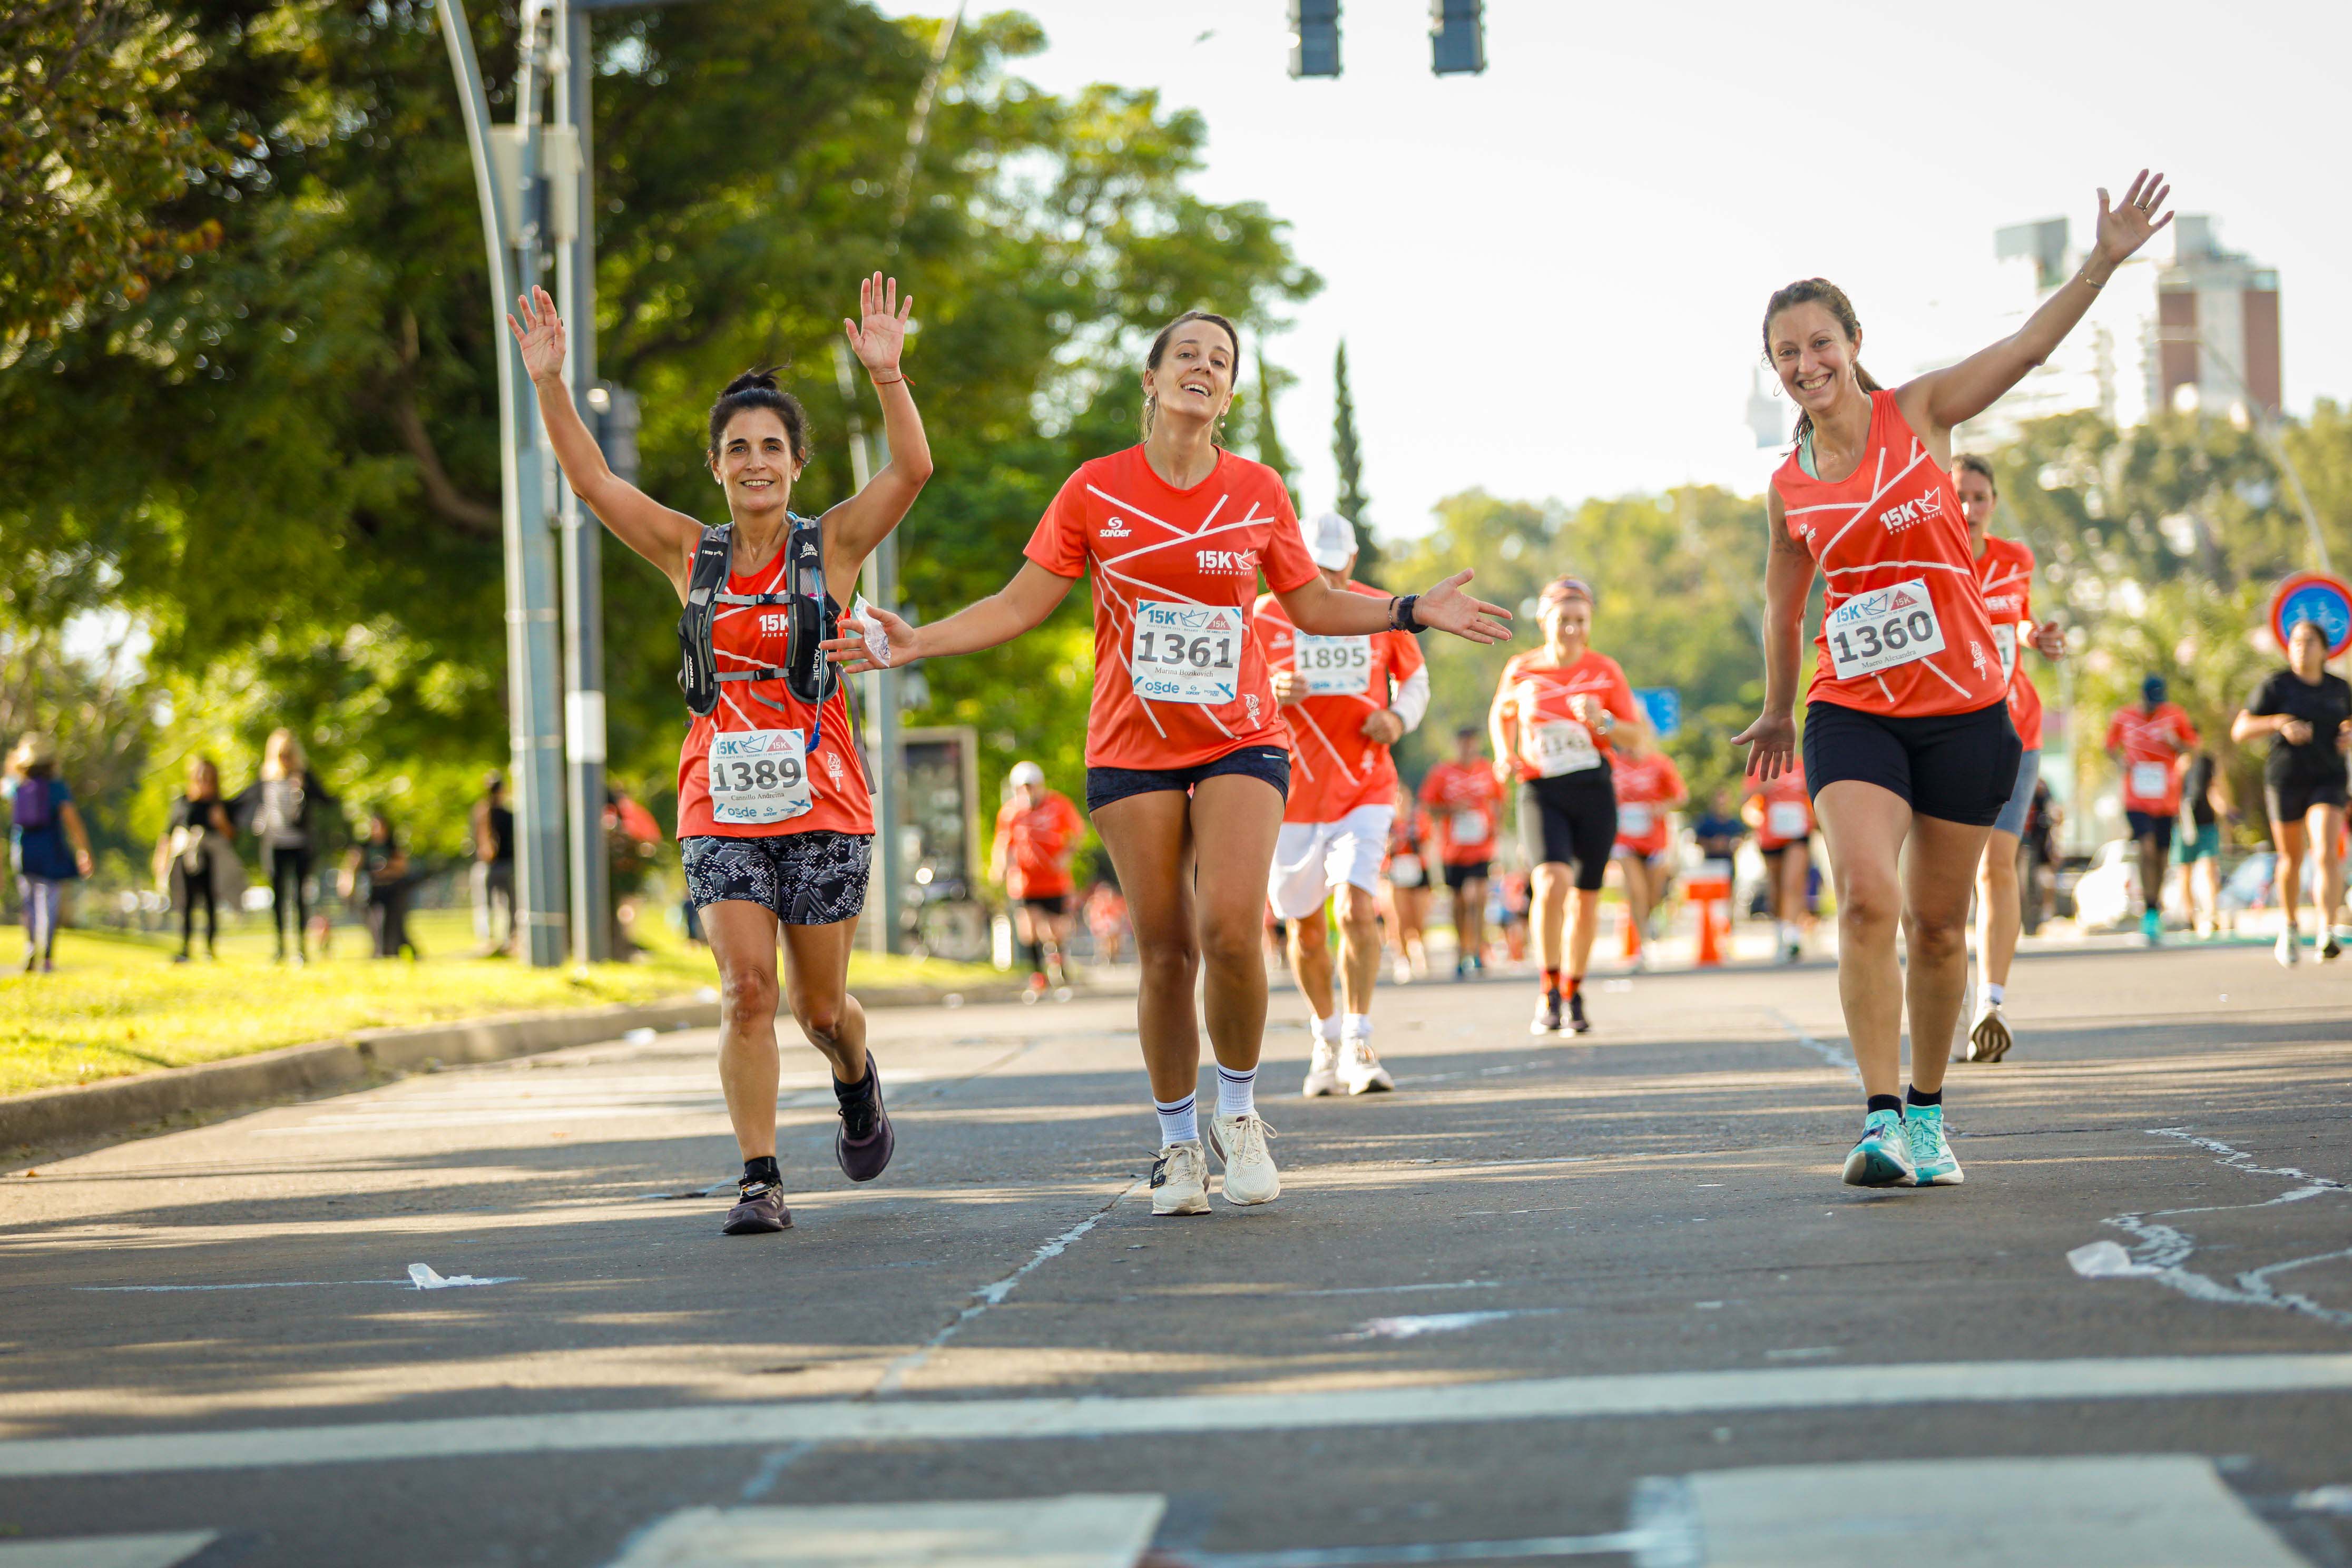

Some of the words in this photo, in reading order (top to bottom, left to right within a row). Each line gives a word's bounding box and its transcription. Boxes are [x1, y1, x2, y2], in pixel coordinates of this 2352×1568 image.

[1880, 500, 1918, 530] 15K
[1889, 520, 1920, 535] PUERTO
[1923, 511, 1943, 521] NORTE
[1196, 550, 1233, 569] 15K
[1895, 596, 1912, 606] 15K
[1148, 609, 1177, 625] 15K
[1836, 604, 1861, 623] 15K
[1212, 620, 1227, 628] 15K
[1833, 610, 1934, 664] 1360
[1138, 631, 1233, 668] 1361
[1300, 646, 1366, 669] 1895
[1861, 660, 1883, 669] Maero
[1884, 650, 1916, 663] Alexandra
[1154, 667, 1178, 675] Marina
[1179, 669, 1213, 678] Bozikovich
[1145, 681, 1180, 694] osde
[716, 740, 738, 754] 15K
[772, 741, 787, 749] 15K
[713, 757, 801, 791] 1389
[728, 805, 757, 817] osde
